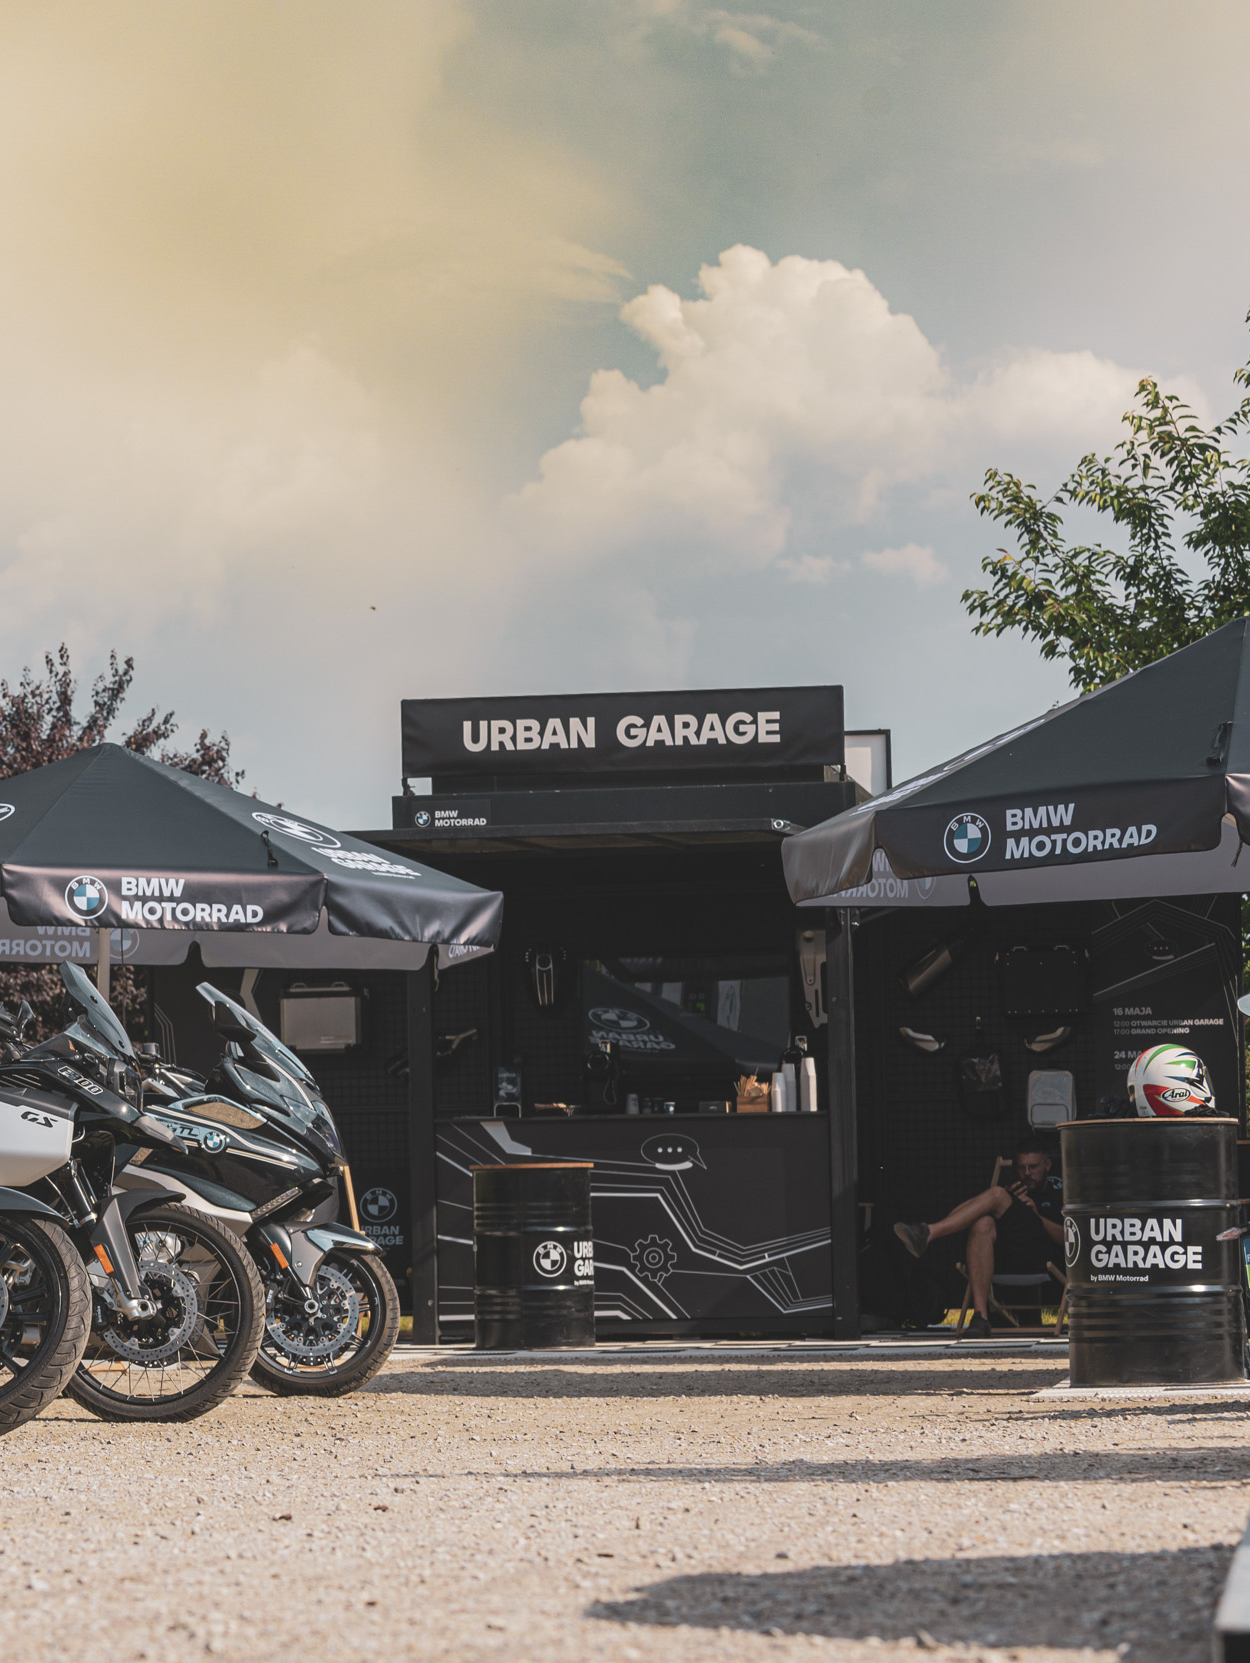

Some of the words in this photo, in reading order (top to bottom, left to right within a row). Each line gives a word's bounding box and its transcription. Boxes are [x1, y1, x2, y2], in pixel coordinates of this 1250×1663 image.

[462, 716, 596, 753] URBAN
[616, 710, 782, 748] GARAGE
[434, 810, 459, 819] BMW
[1005, 803, 1075, 832] BMW
[434, 818, 487, 827] MOTORRAD
[950, 815, 985, 831] BMW
[1005, 824, 1158, 860] MOTORRAD
[70, 877, 102, 890] BMW
[121, 877, 185, 897] BMW
[121, 901, 264, 924] MOTORRAD
[1113, 1007, 1124, 1016] 16
[1125, 1007, 1152, 1016] MAJA
[1130, 1019, 1168, 1027] OTWARCIE
[1193, 1018, 1224, 1026] GARAGE
[1157, 1027, 1190, 1035] OPENING
[1113, 1050, 1127, 1059] 24
[1167, 1089, 1189, 1099] Arai
[20, 1111, 59, 1128] GS
[1089, 1218, 1183, 1242] URBAN
[368, 1236, 404, 1246] RAGE
[1090, 1244, 1203, 1270] GARAGE
[1090, 1275, 1098, 1283] by
[1098, 1274, 1115, 1282] BMW
[1116, 1274, 1149, 1282] Motorrad
